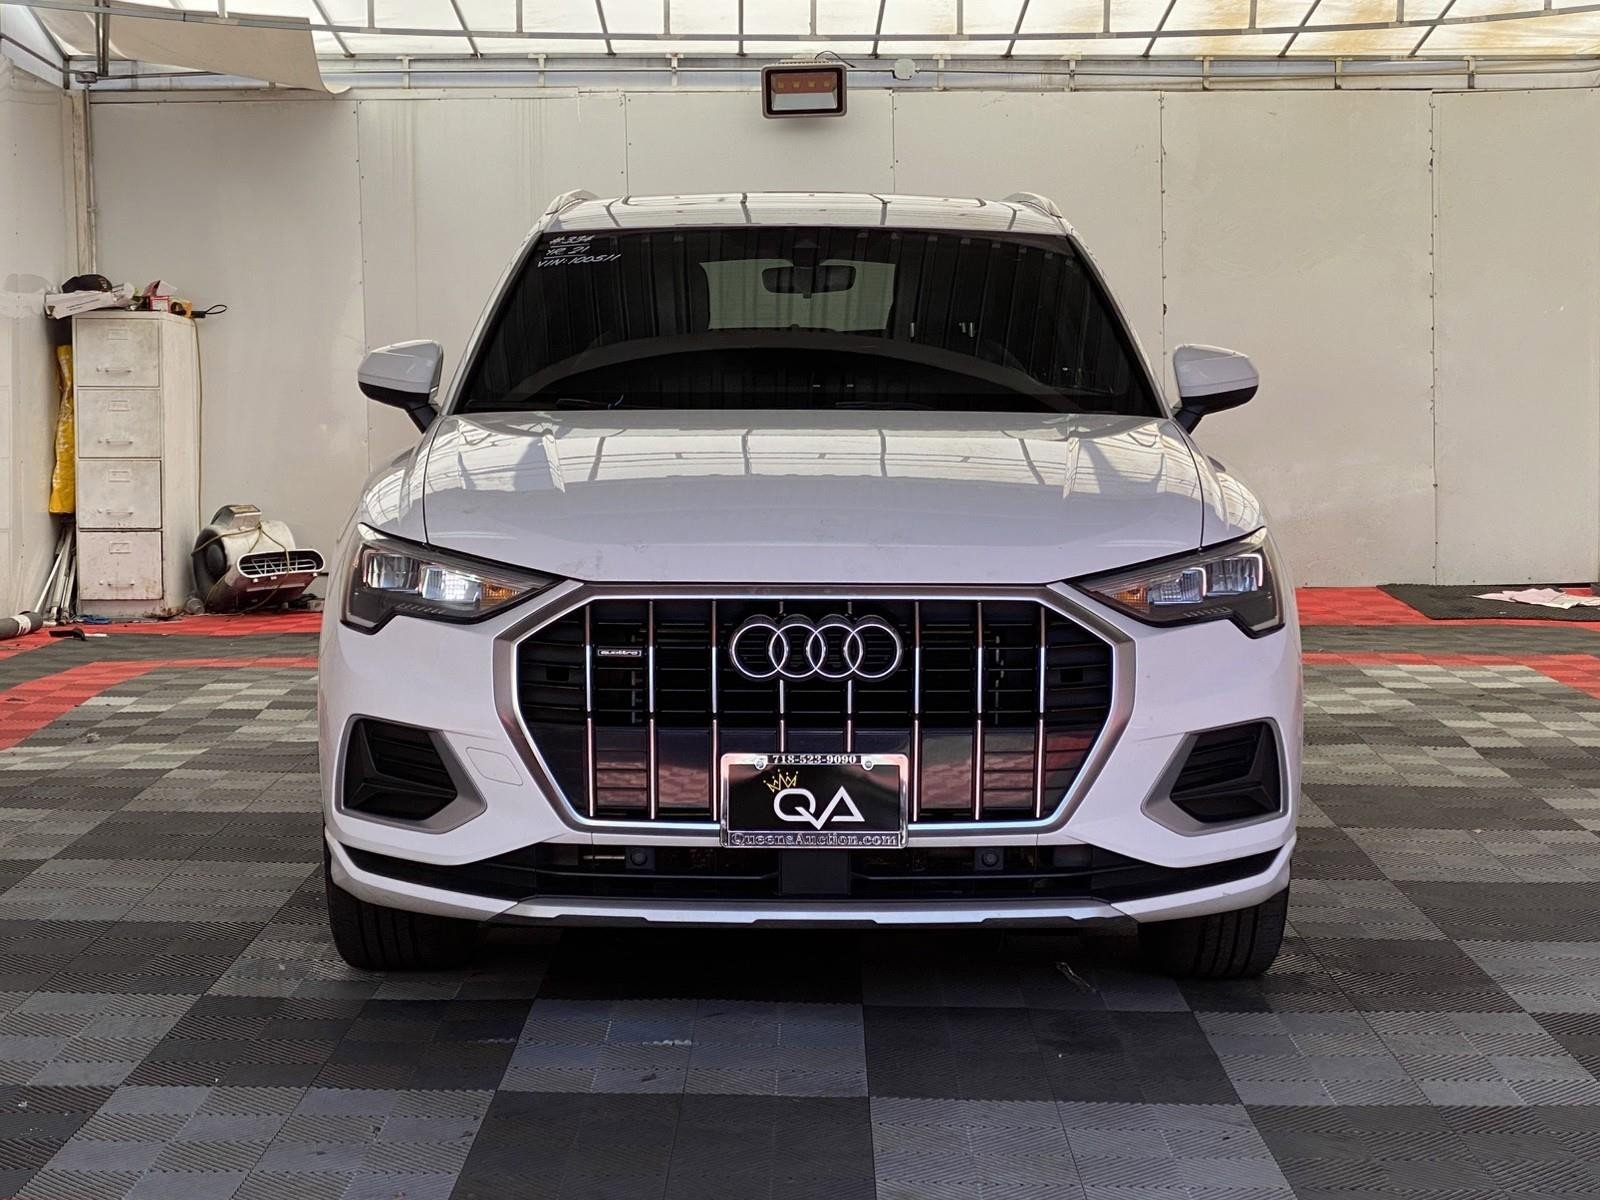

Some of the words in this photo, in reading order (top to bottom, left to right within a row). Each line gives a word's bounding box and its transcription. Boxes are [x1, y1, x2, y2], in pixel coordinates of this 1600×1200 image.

[772, 754, 857, 764] 718-523-9090
[773, 785, 866, 831] QA
[730, 832, 897, 847] QueensAuction.com
